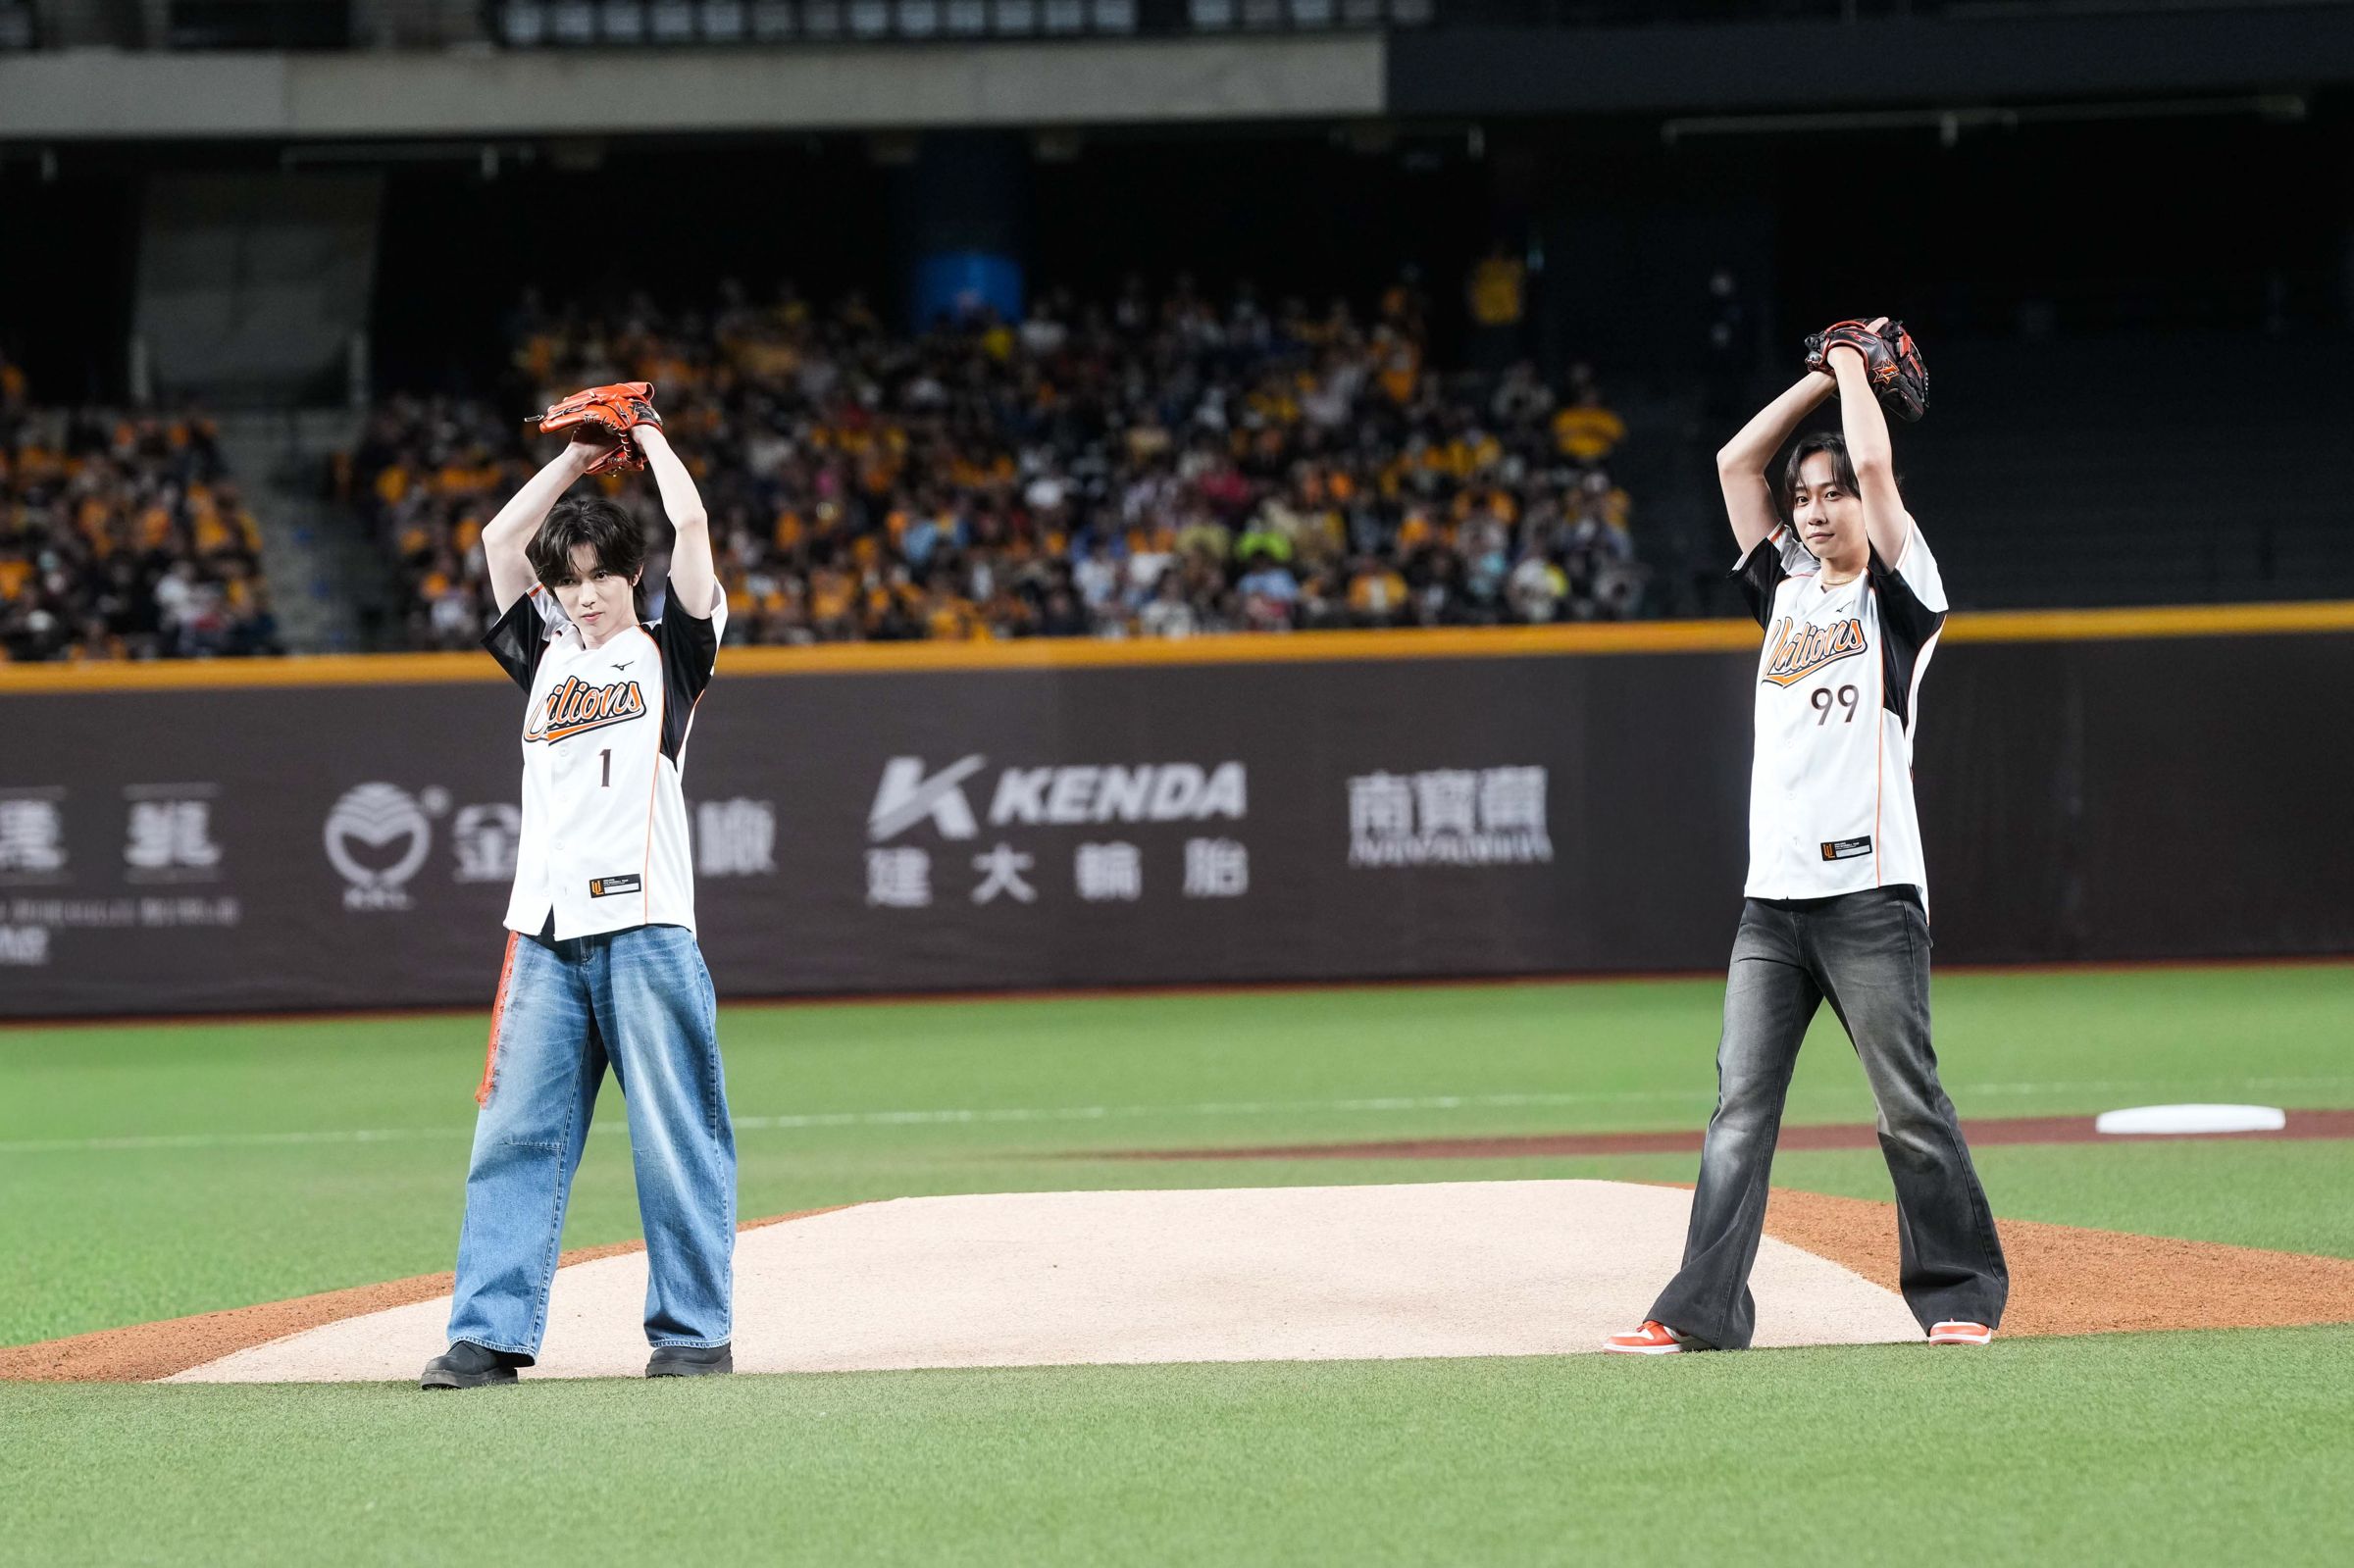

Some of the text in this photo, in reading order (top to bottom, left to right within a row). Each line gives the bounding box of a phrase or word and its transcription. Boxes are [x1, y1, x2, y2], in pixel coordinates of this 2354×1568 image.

[1811, 684, 1860, 726] 99
[599, 748, 612, 787] 1
[988, 760, 1248, 826] KENDA
